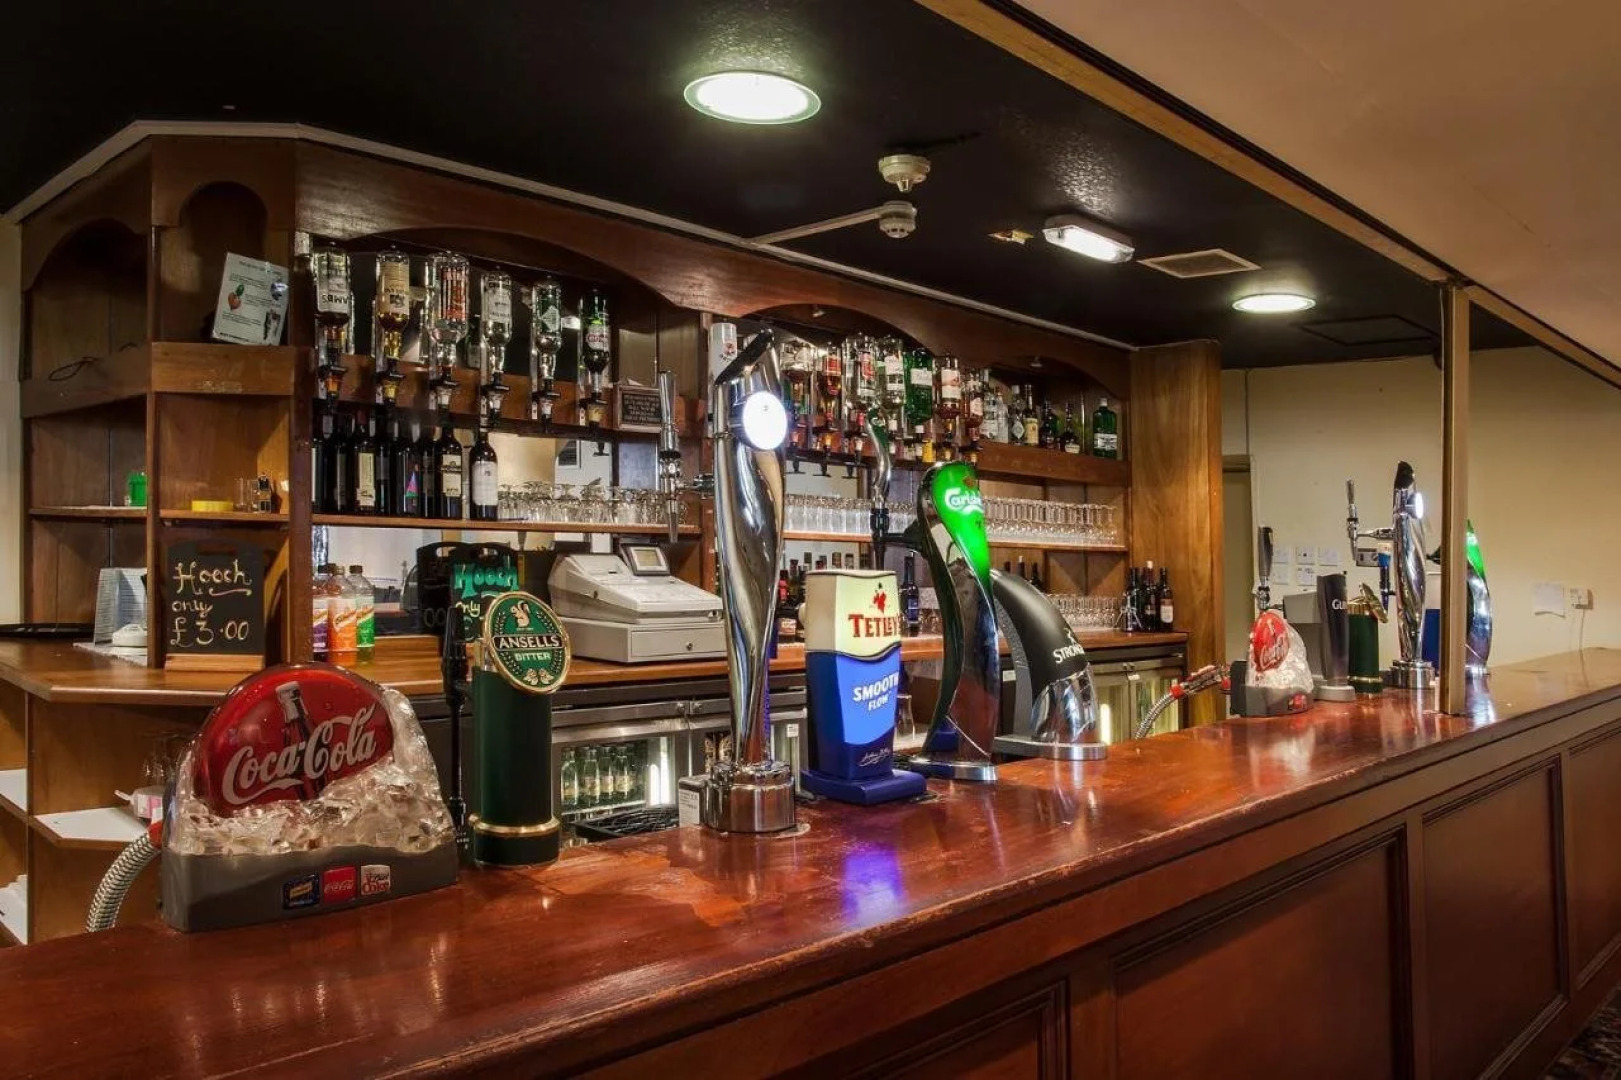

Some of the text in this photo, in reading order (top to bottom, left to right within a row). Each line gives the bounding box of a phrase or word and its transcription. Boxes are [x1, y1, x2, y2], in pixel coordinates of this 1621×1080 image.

[173, 559, 252, 595] Hooch
[171, 600, 213, 618] only
[499, 636, 560, 649] ANSELLS
[514, 652, 551, 662] BITTER
[868, 694, 888, 711] FLOW
[222, 703, 377, 805] Coca-Cola
